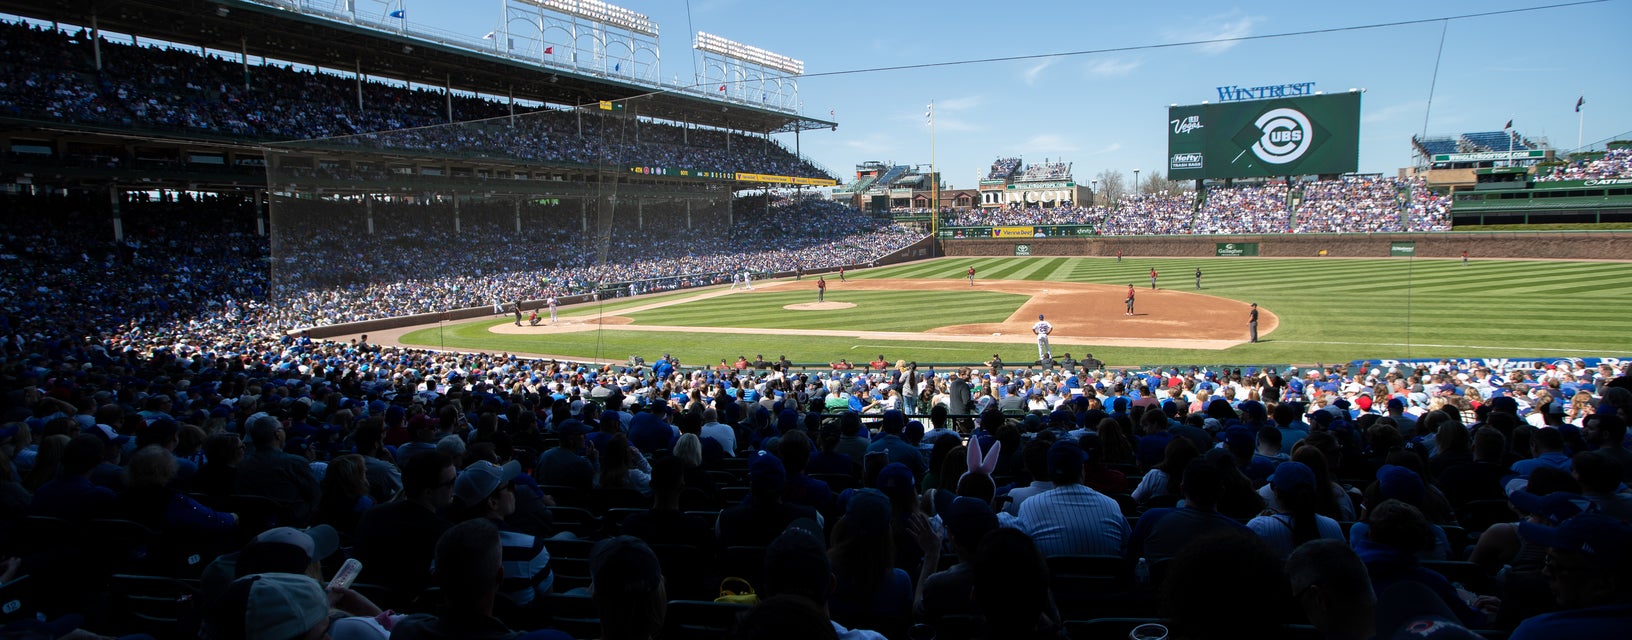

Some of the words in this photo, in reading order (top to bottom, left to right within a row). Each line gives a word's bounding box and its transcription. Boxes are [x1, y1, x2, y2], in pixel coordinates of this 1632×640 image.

[1217, 83, 1315, 102] WINTRUST
[1171, 118, 1204, 134] Vegas
[1173, 154, 1200, 162] Hefty
